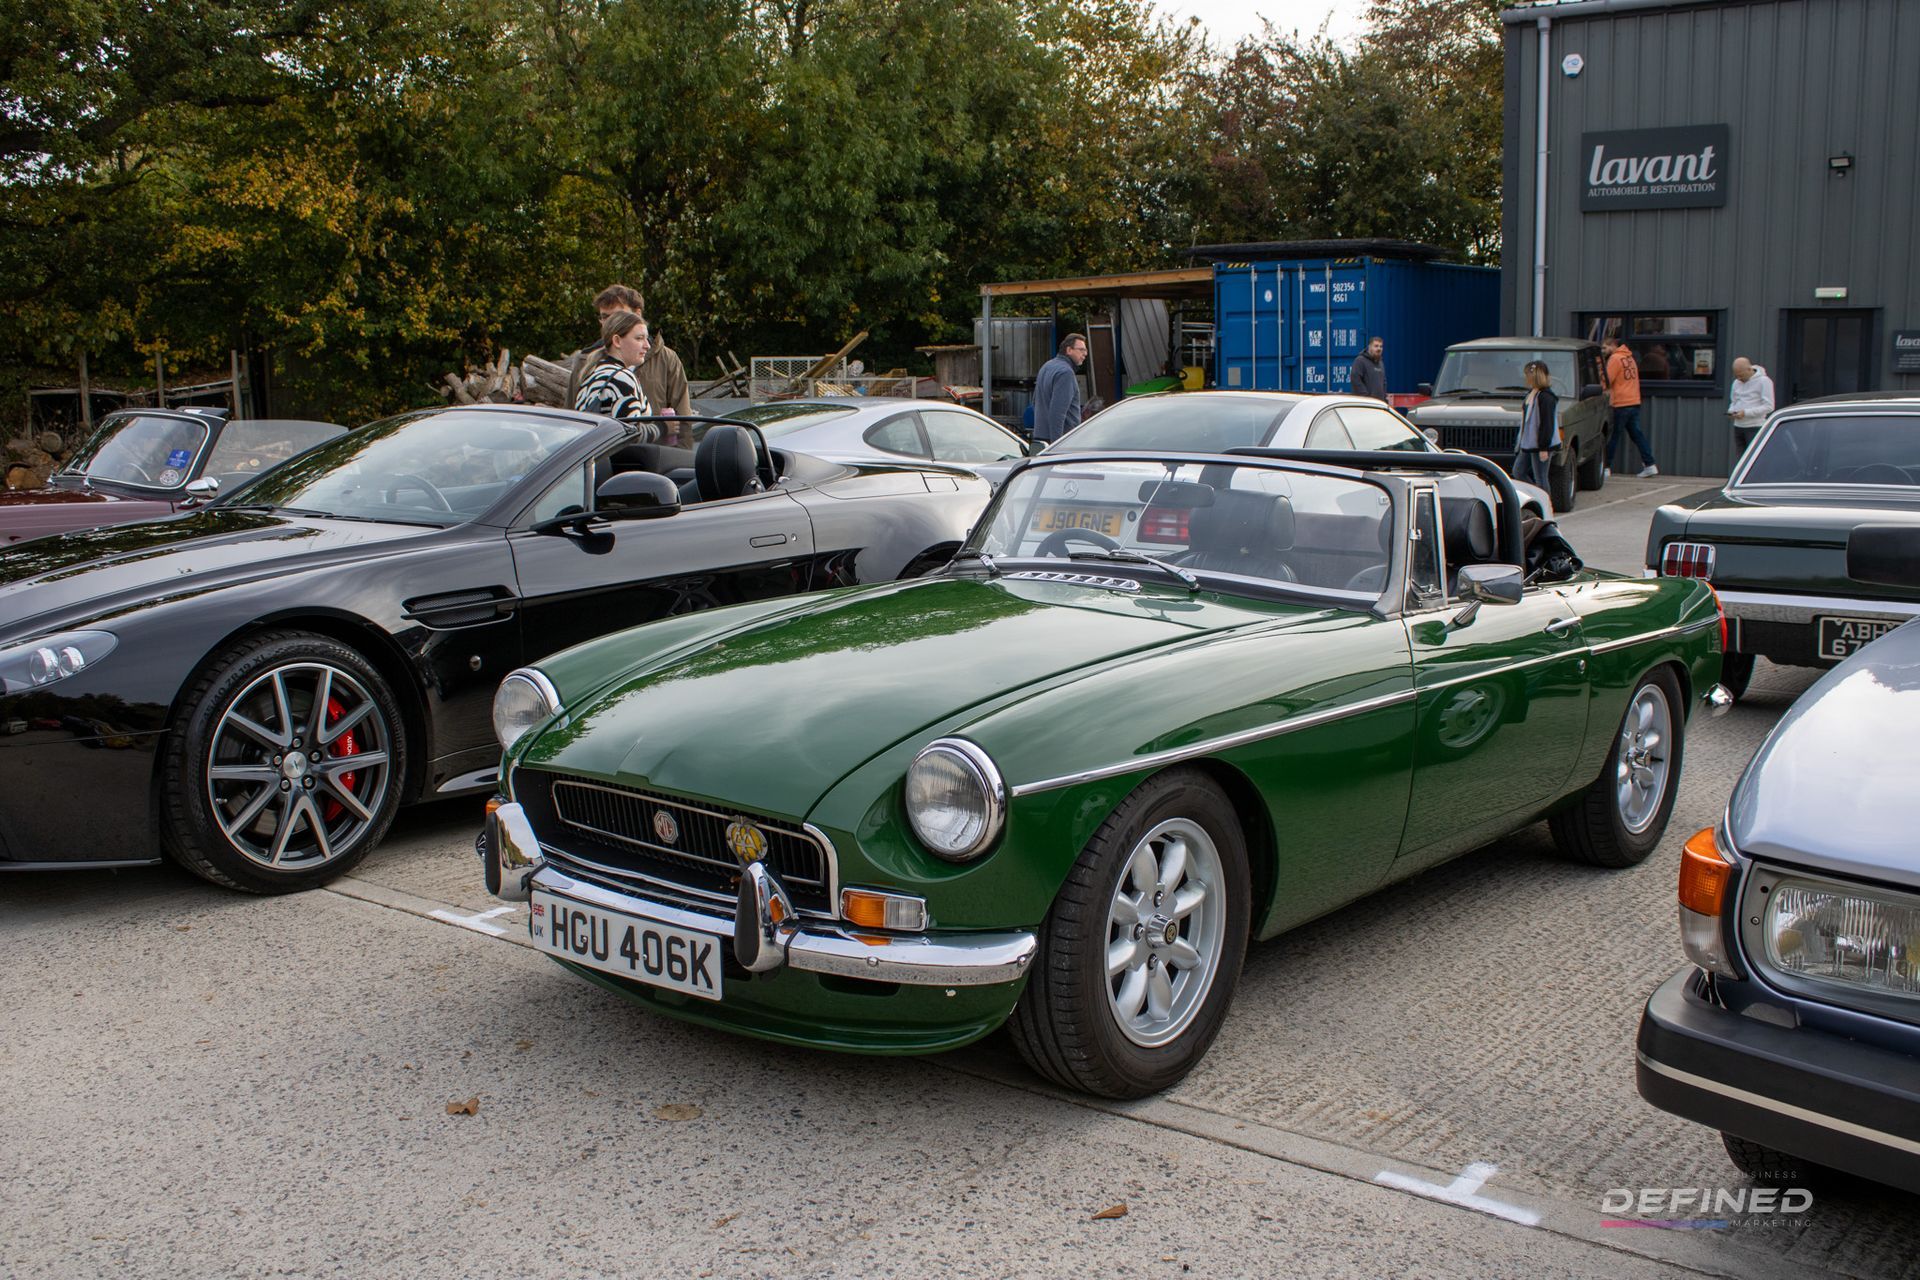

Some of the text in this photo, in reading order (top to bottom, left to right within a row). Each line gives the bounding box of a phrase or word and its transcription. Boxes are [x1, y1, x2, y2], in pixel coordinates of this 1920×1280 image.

[1588, 144, 1717, 186] lavant
[1588, 182, 1716, 197] AUTOMOBILE RESTORATION
[1332, 282, 1355, 293] 502356
[1046, 511, 1113, 534] J90 GNE
[1832, 639, 1870, 655] 67
[656, 815, 674, 839] MG
[551, 904, 714, 990] HGU 406K
